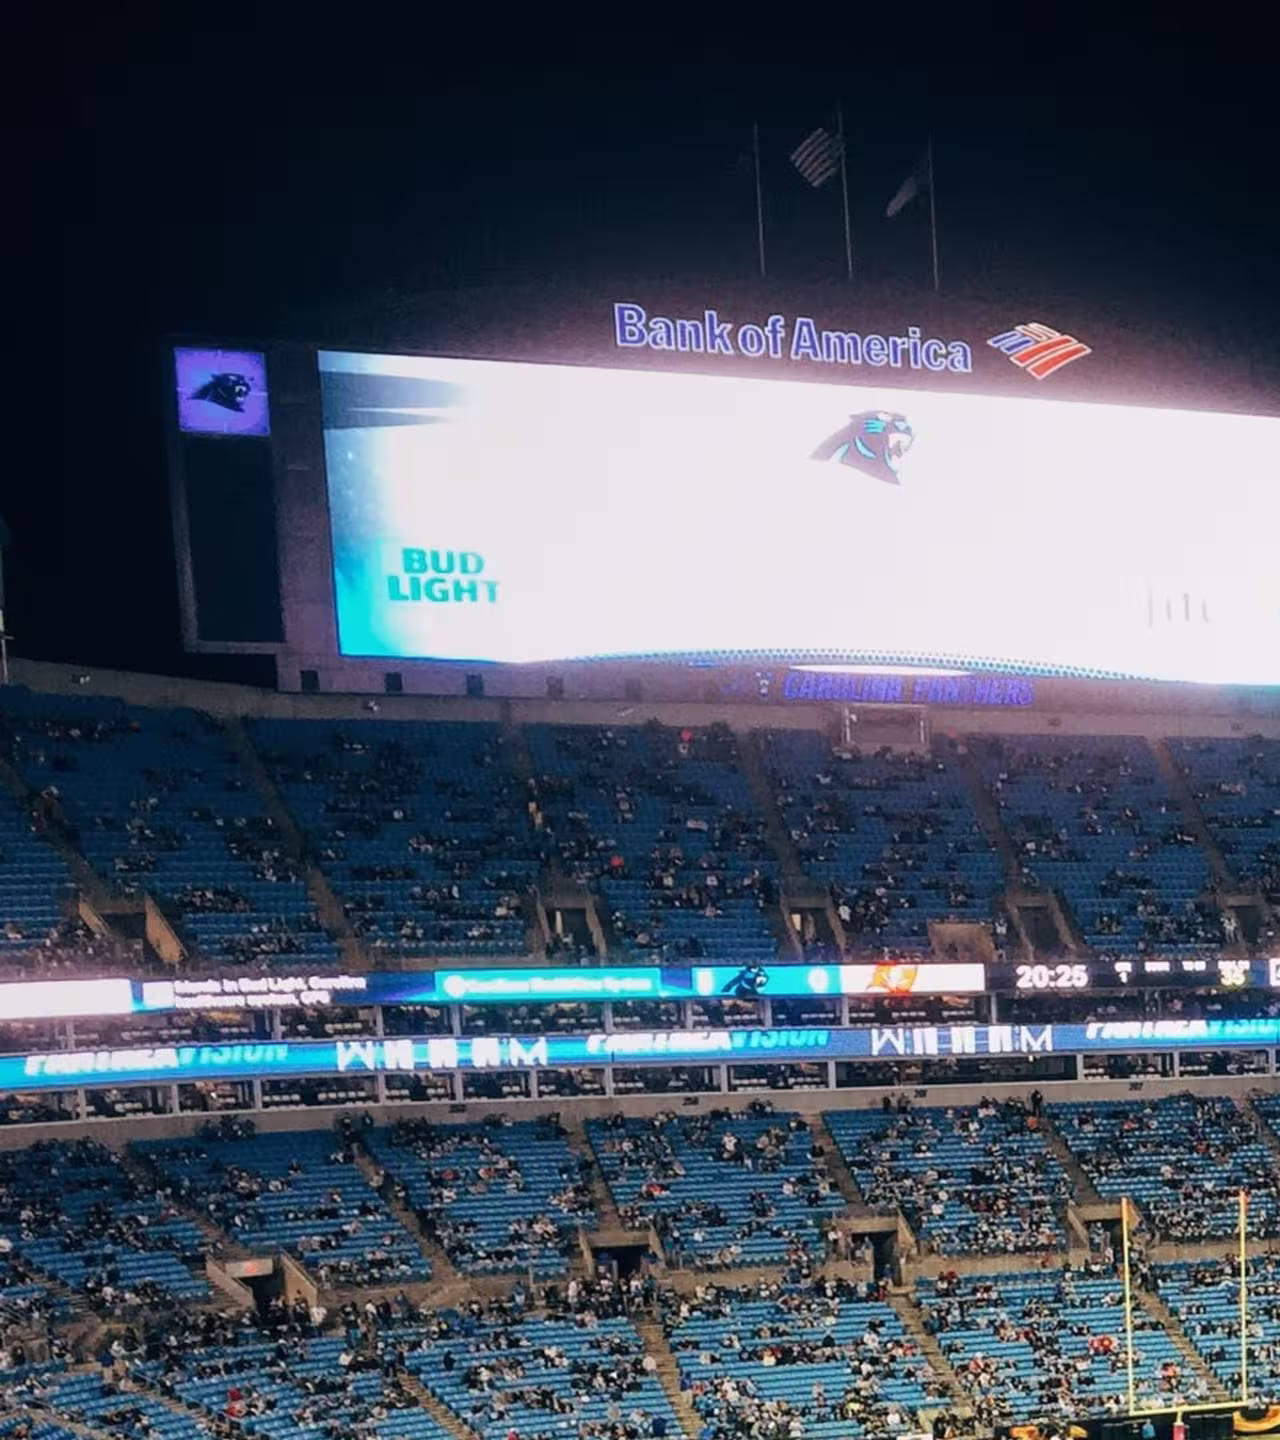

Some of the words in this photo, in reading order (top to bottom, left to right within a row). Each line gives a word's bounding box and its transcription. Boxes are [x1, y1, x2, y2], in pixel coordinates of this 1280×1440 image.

[614, 303, 734, 355] Bank
[737, 315, 784, 358] of
[791, 317, 973, 373] America
[401, 547, 485, 575] BUD
[386, 575, 500, 603] LIGHT
[784, 672, 905, 701] CAROLINA
[913, 676, 1036, 705] PANTHERS
[1015, 963, 1089, 989] 20:25
